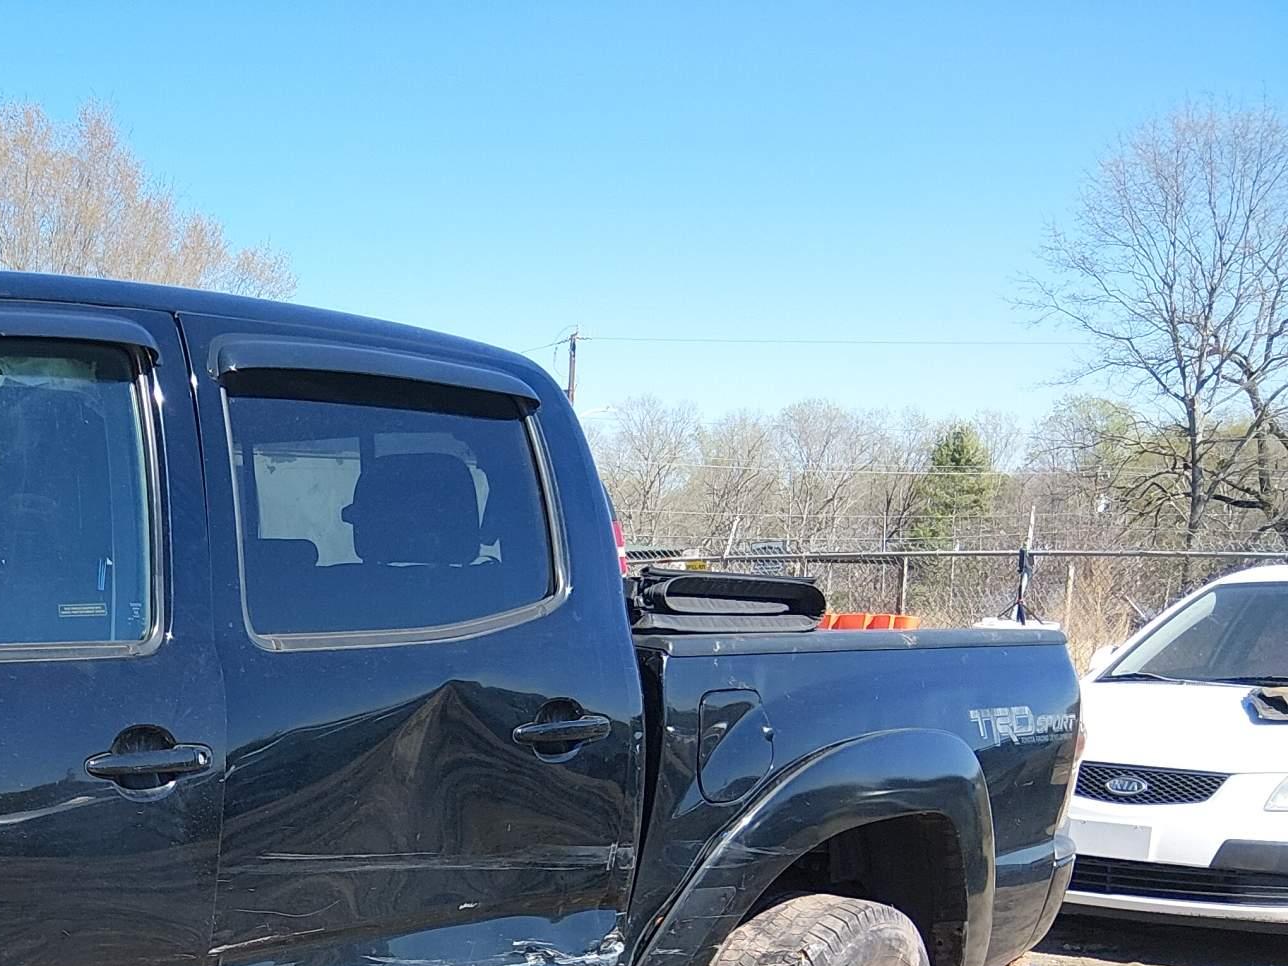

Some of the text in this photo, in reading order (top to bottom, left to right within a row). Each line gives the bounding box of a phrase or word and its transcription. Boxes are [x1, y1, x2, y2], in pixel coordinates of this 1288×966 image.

[969, 706, 1034, 746] TRD
[1036, 713, 1076, 733] SPORT
[1111, 779, 1138, 791] KIA
